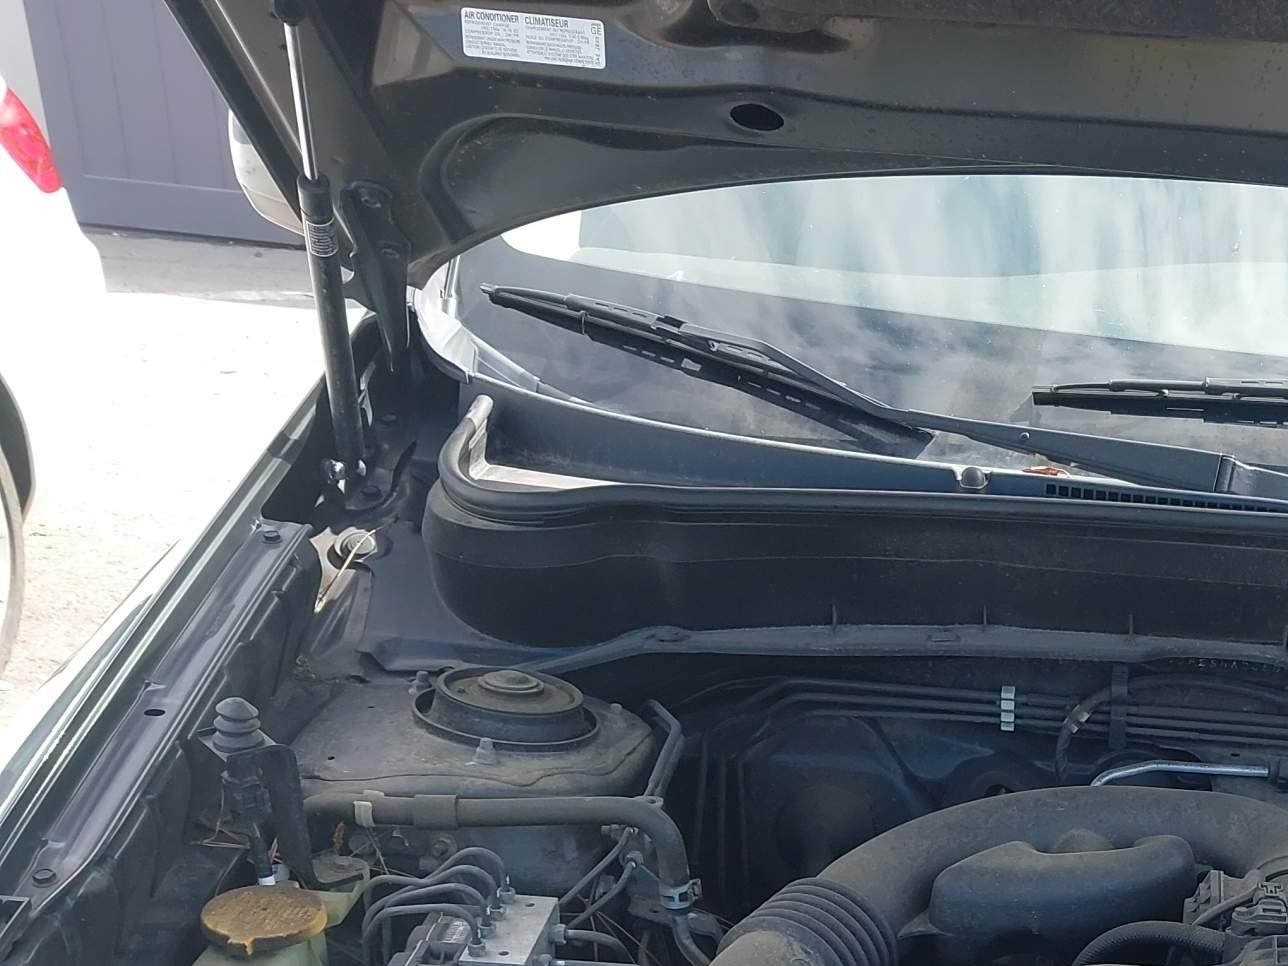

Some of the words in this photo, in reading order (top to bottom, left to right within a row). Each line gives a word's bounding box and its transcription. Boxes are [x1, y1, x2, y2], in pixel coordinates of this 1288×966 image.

[464, 10, 475, 19] AIR
[476, 11, 519, 24] CONDITIONER
[524, 16, 569, 28] CLIMATISEUR
[591, 26, 602, 34] GE
